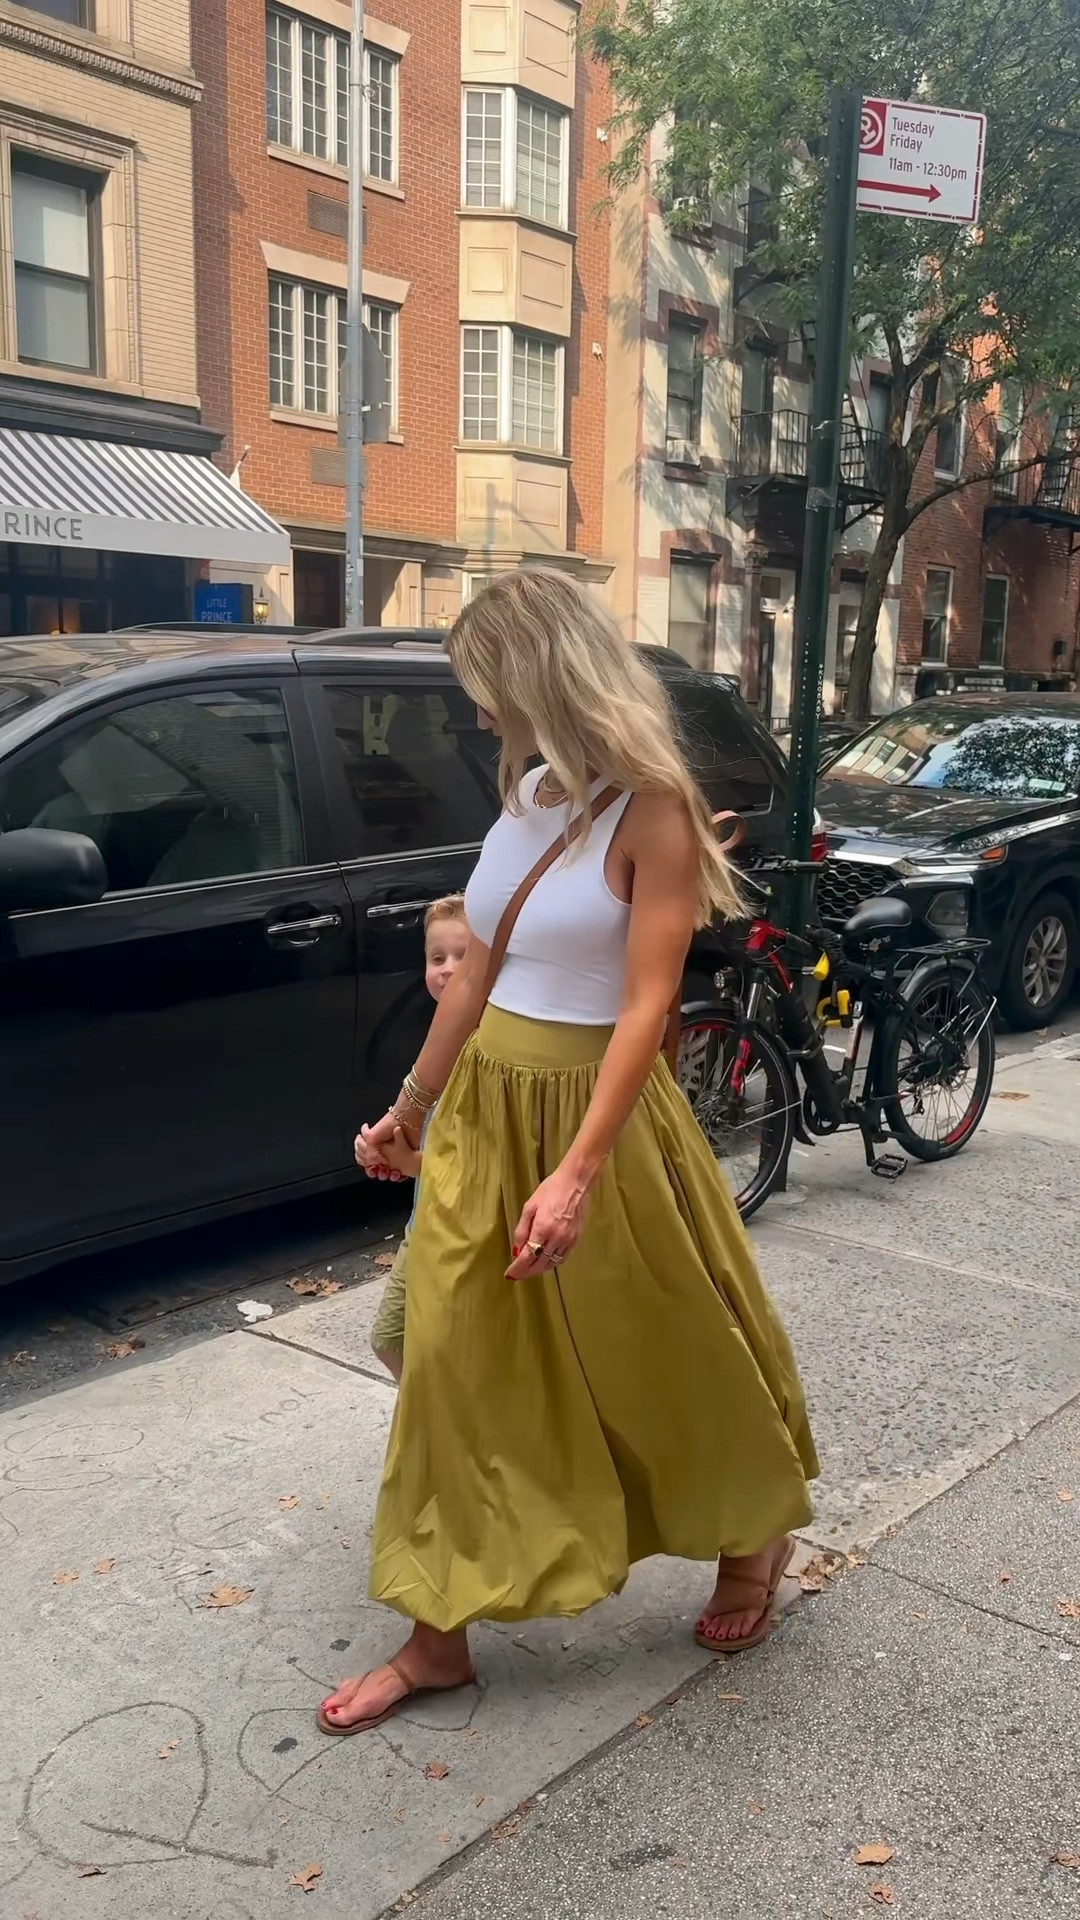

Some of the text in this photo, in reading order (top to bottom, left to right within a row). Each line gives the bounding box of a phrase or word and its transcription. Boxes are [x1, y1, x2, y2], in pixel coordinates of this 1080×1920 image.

[892, 117, 934, 137] Tuesday
[890, 134, 922, 153] Friday
[889, 157, 913, 172] 11am
[923, 162, 967, 180] 12:30pm
[4, 511, 83, 540] RINCE
[207, 598, 228, 608] LITTLE
[201, 610, 232, 623] PRINCE
